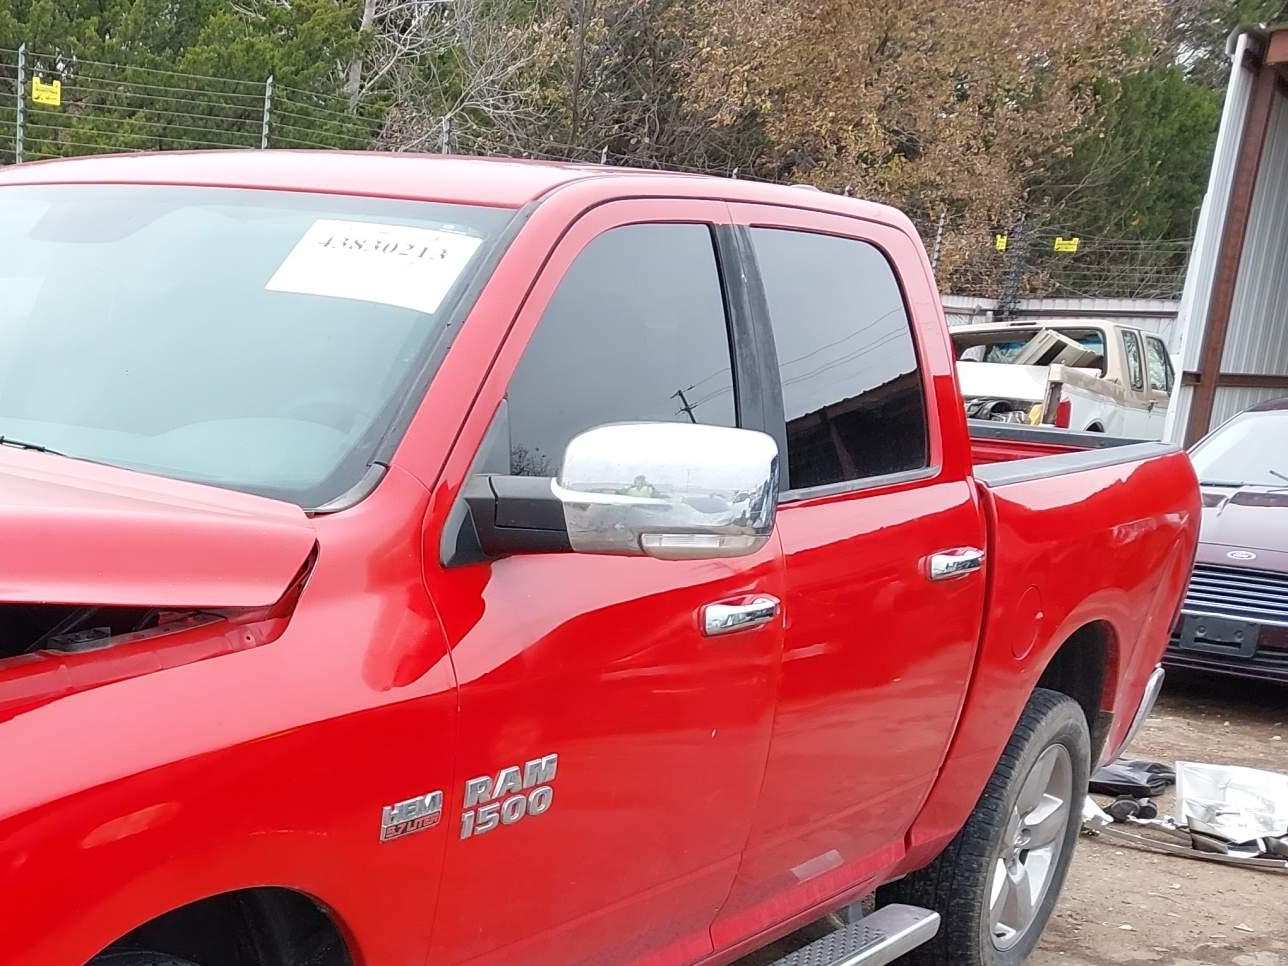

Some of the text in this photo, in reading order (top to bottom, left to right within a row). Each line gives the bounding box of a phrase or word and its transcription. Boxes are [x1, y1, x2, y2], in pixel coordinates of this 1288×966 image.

[318, 235, 449, 260] 43830213
[462, 753, 558, 808] RAM
[459, 785, 554, 839] 1500
